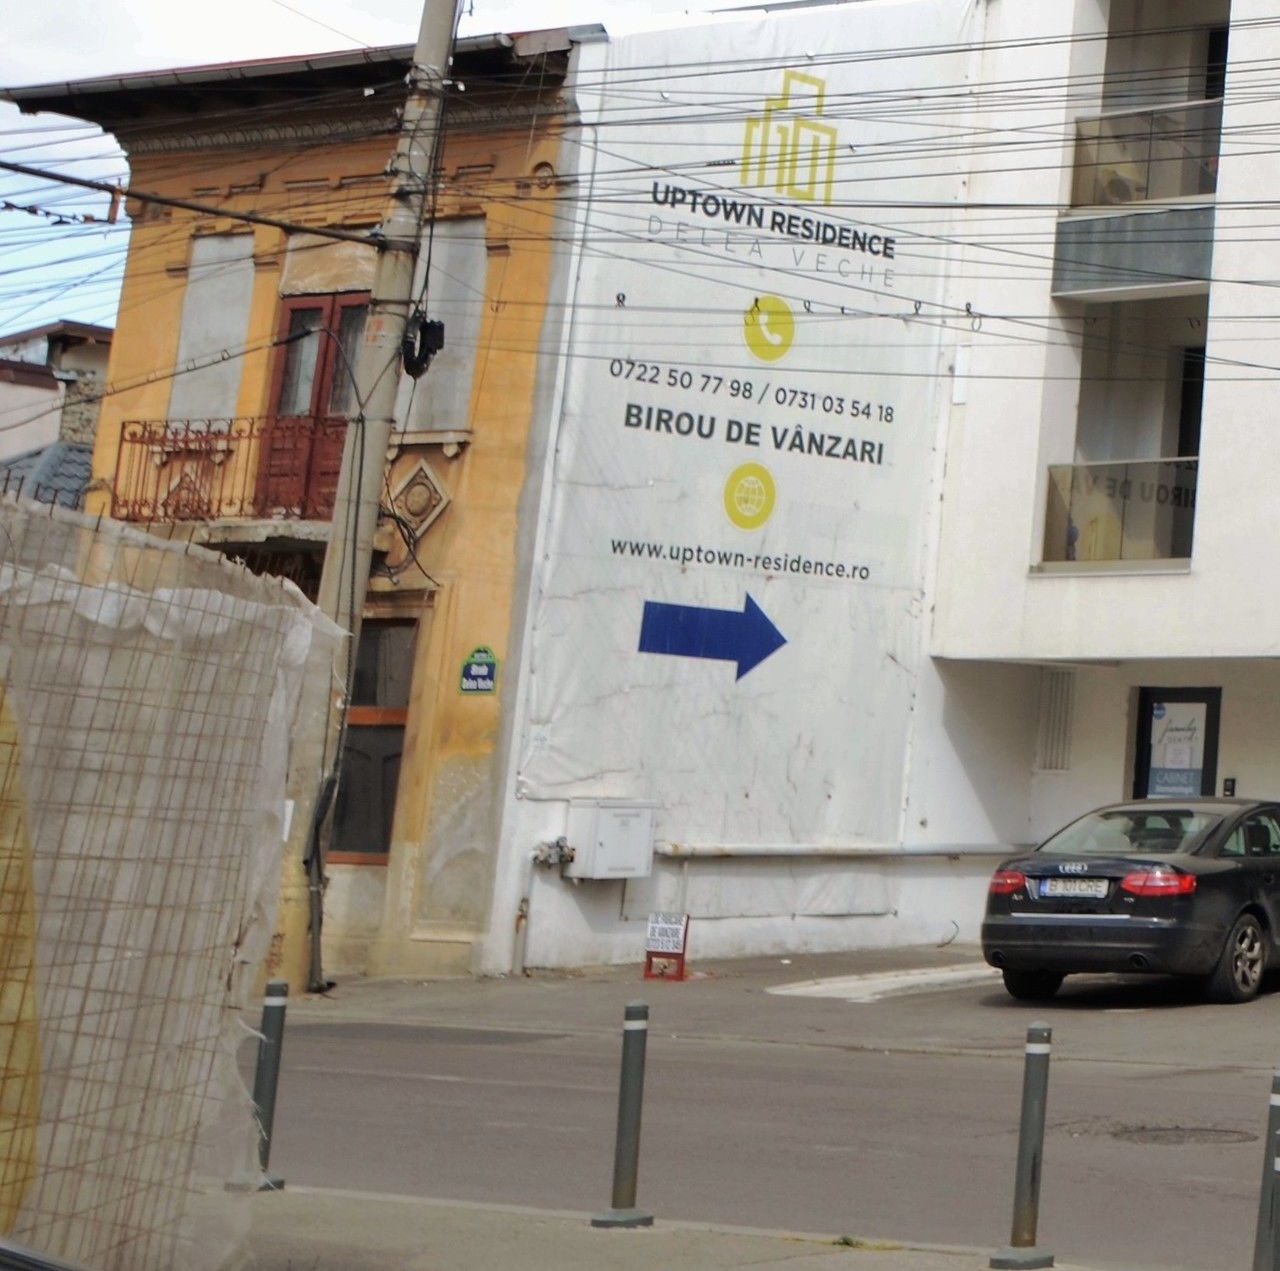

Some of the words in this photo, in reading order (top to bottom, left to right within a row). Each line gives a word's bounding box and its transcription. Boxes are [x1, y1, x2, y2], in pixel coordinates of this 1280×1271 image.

[648, 215, 763, 258] DELEA
[793, 247, 895, 288] VECHE
[652, 182, 764, 228] UPTOWN
[770, 211, 896, 259] RESIDENCE
[609, 358, 660, 384] 0722
[667, 369, 693, 389] 50
[700, 374, 723, 394] 77
[730, 379, 753, 399] 98
[774, 387, 816, 411] 0731
[822, 396, 844, 415] 03
[850, 400, 871, 420] 54
[878, 405, 895, 424] 18
[624, 403, 716, 439] BIROU
[726, 420, 762, 447] DE
[771, 425, 884, 465] VÂNZARI
[611, 538, 870, 580] www.uptown-residence.ro
